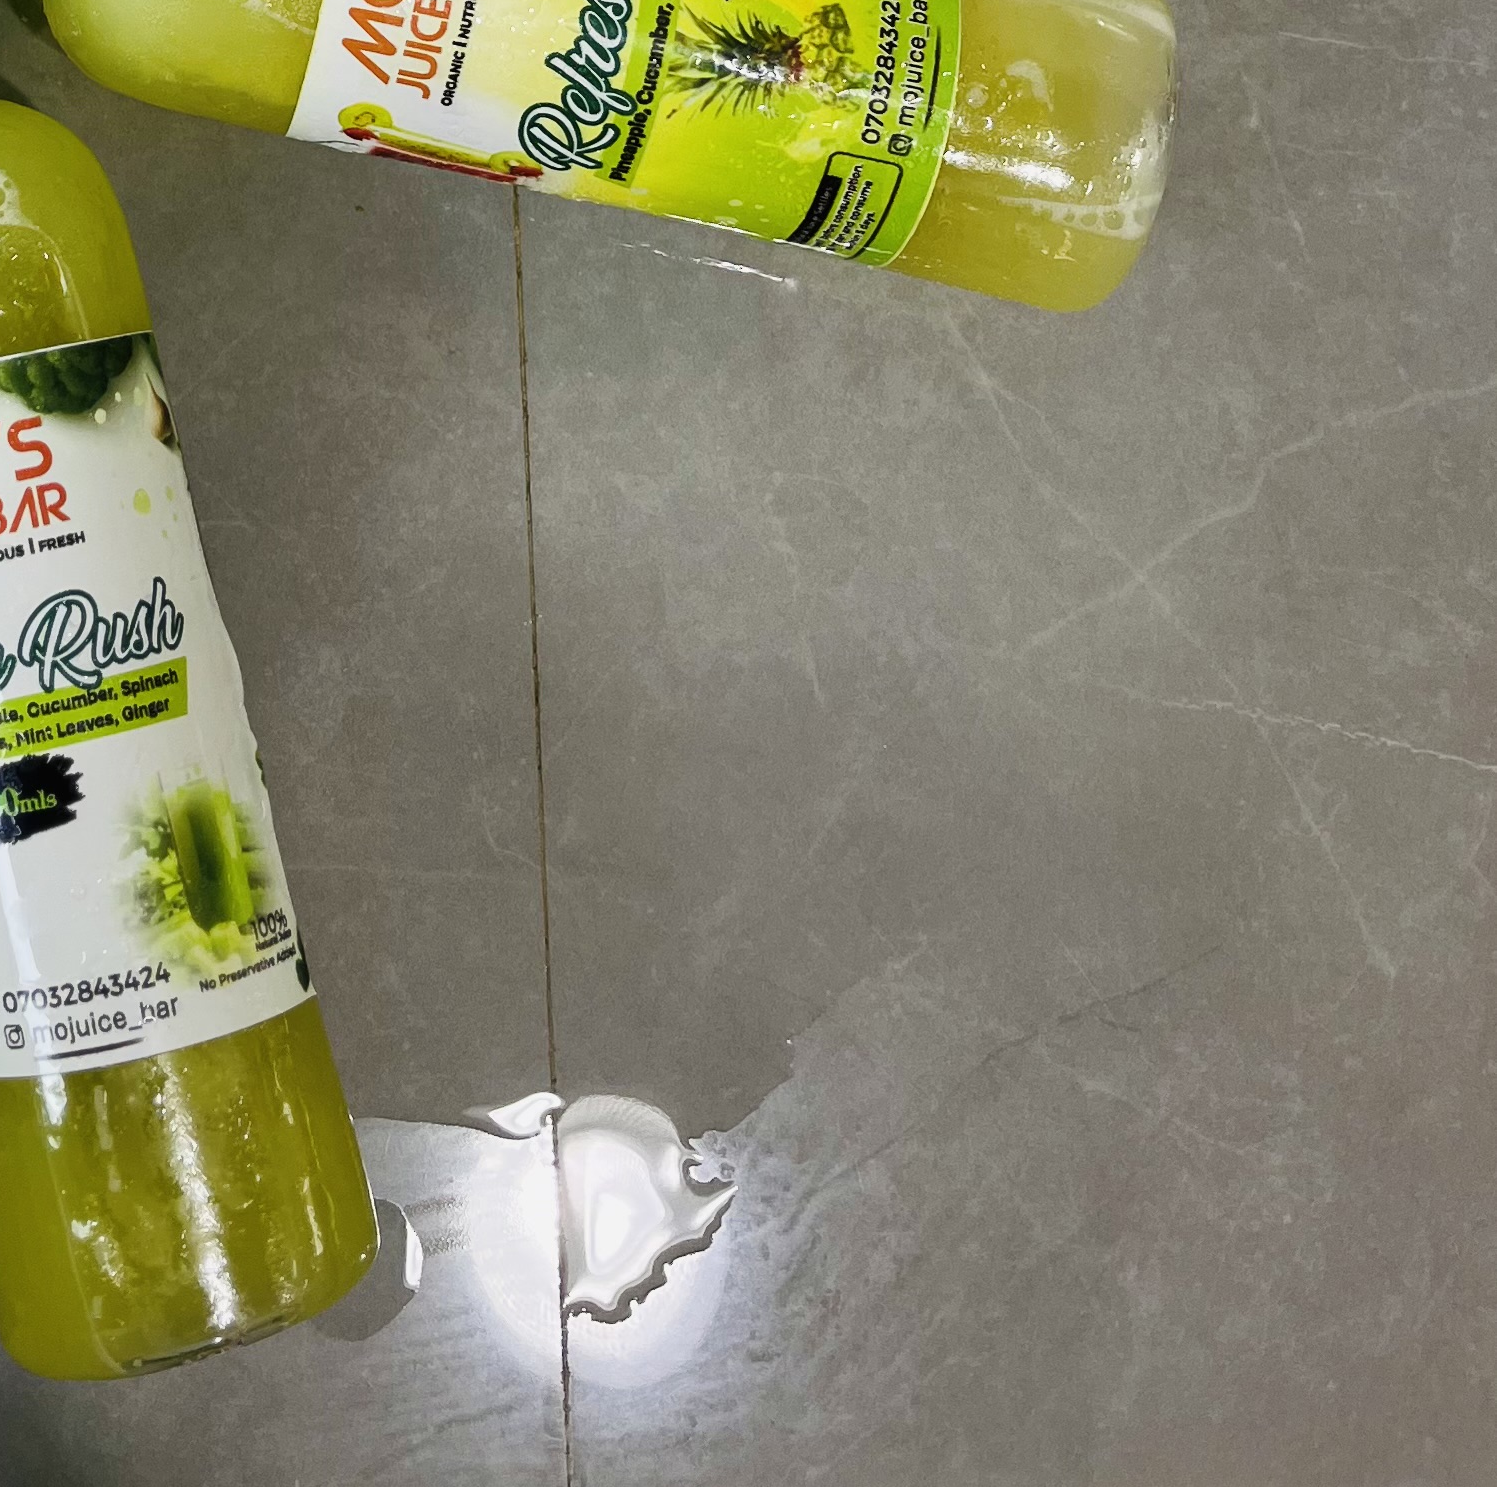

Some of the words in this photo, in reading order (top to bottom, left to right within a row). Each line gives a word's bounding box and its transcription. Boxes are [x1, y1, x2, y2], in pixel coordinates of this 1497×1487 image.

[439, 50, 465, 107] ORGANIC
[608, 107, 652, 181] Pineapple,
[634, 2, 674, 105] Cucumber,
[37, 530, 85, 552] FRESH
[18, 575, 184, 693] Rush
[25, 684, 119, 718] Cucumber,
[119, 667, 179, 697] Spinach
[14, 725, 53, 747] Mint
[55, 711, 119, 739] Leaves,
[121, 697, 170, 722] Ginger
[251, 907, 287, 940] 100%
[1, 961, 170, 1014] 07032843424
[198, 977, 217, 992] No
[31, 995, 177, 1043] mojuice_bar
